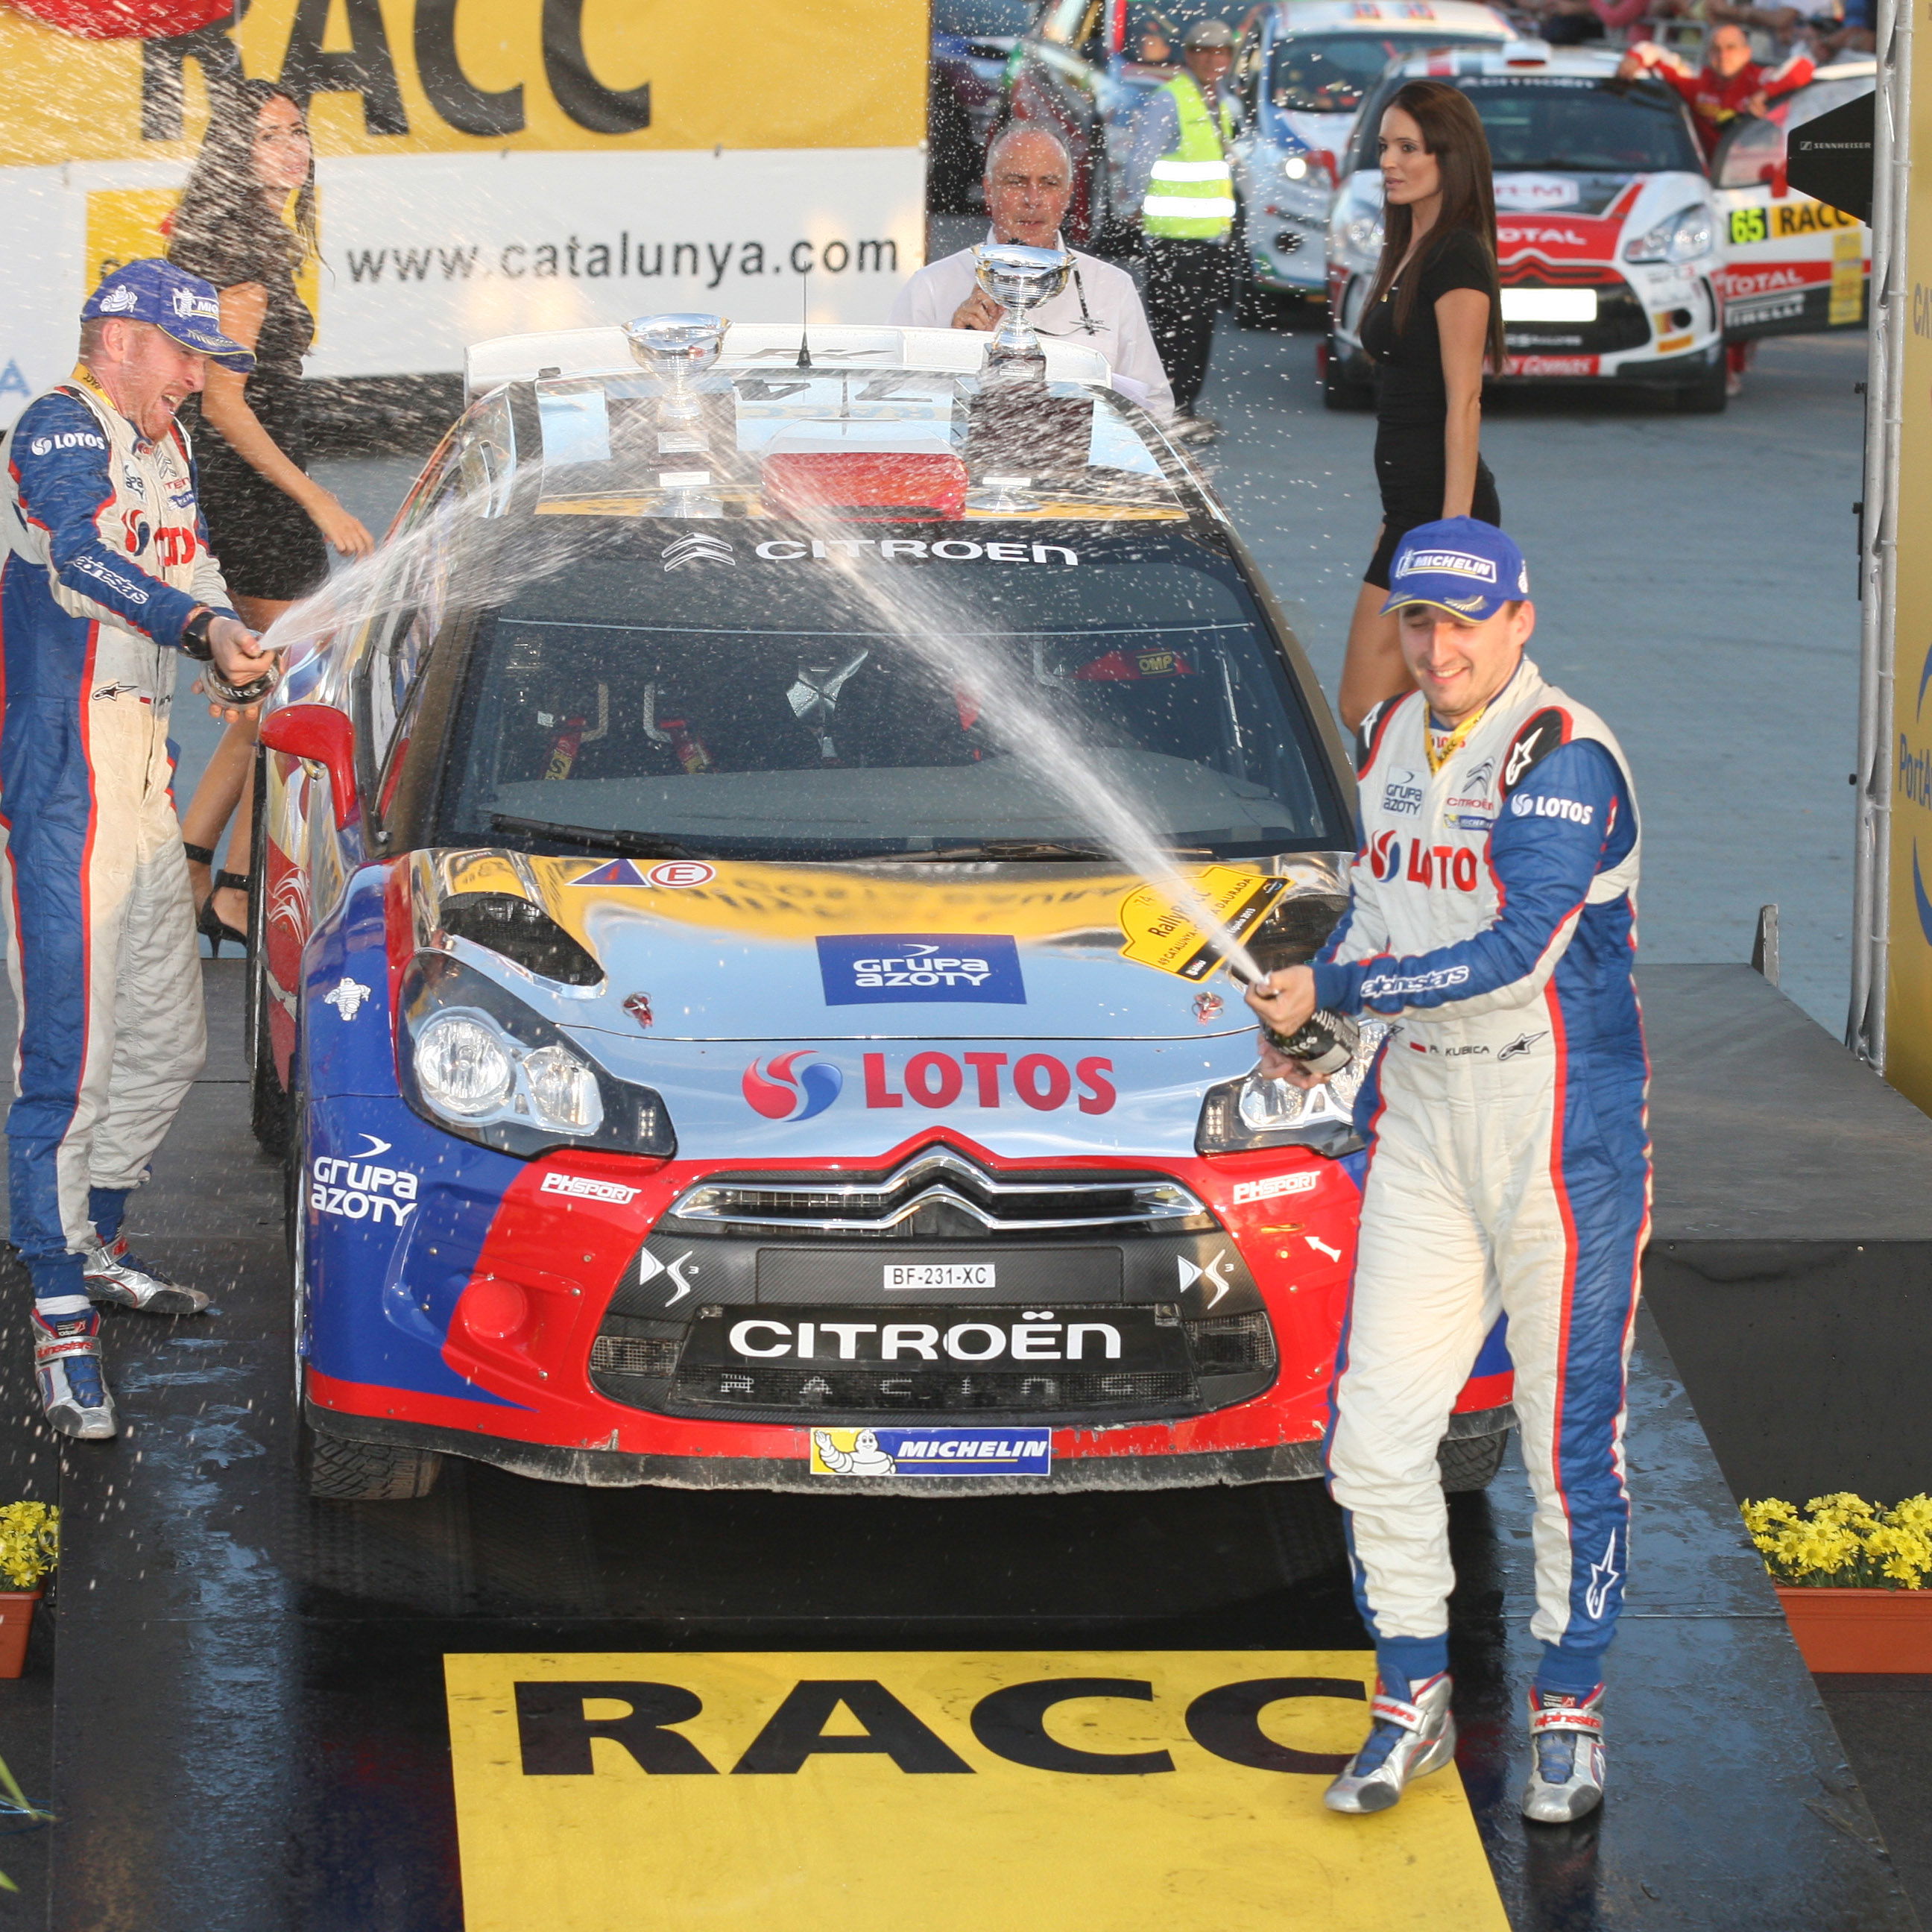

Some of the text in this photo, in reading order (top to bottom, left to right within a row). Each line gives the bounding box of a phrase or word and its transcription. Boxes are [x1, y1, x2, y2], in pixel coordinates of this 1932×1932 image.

[1813, 141, 1872, 149] SENNHEISER
[1731, 207, 1766, 244] 65
[1495, 227, 1588, 246] OTAL
[347, 231, 900, 289] www.catalunya.com
[54, 432, 105, 450] LOTOS
[1413, 555, 1490, 576] MICHELIN
[1138, 654, 1173, 672] OMP
[1898, 733, 1932, 810] PortA
[1535, 795, 1594, 825] LOTOS
[1133, 895, 1155, 908] 74
[1218, 878, 1254, 909] DAURADA
[1445, 1046, 1490, 1057] KUBICA
[862, 1051, 1117, 1115] LOTOS
[892, 1266, 988, 1285] BF-231-XC
[728, 1310, 1122, 1360] CITROËN
[896, 1440, 1048, 1459] MICHELIN
[512, 1676, 1368, 1776] RACC
